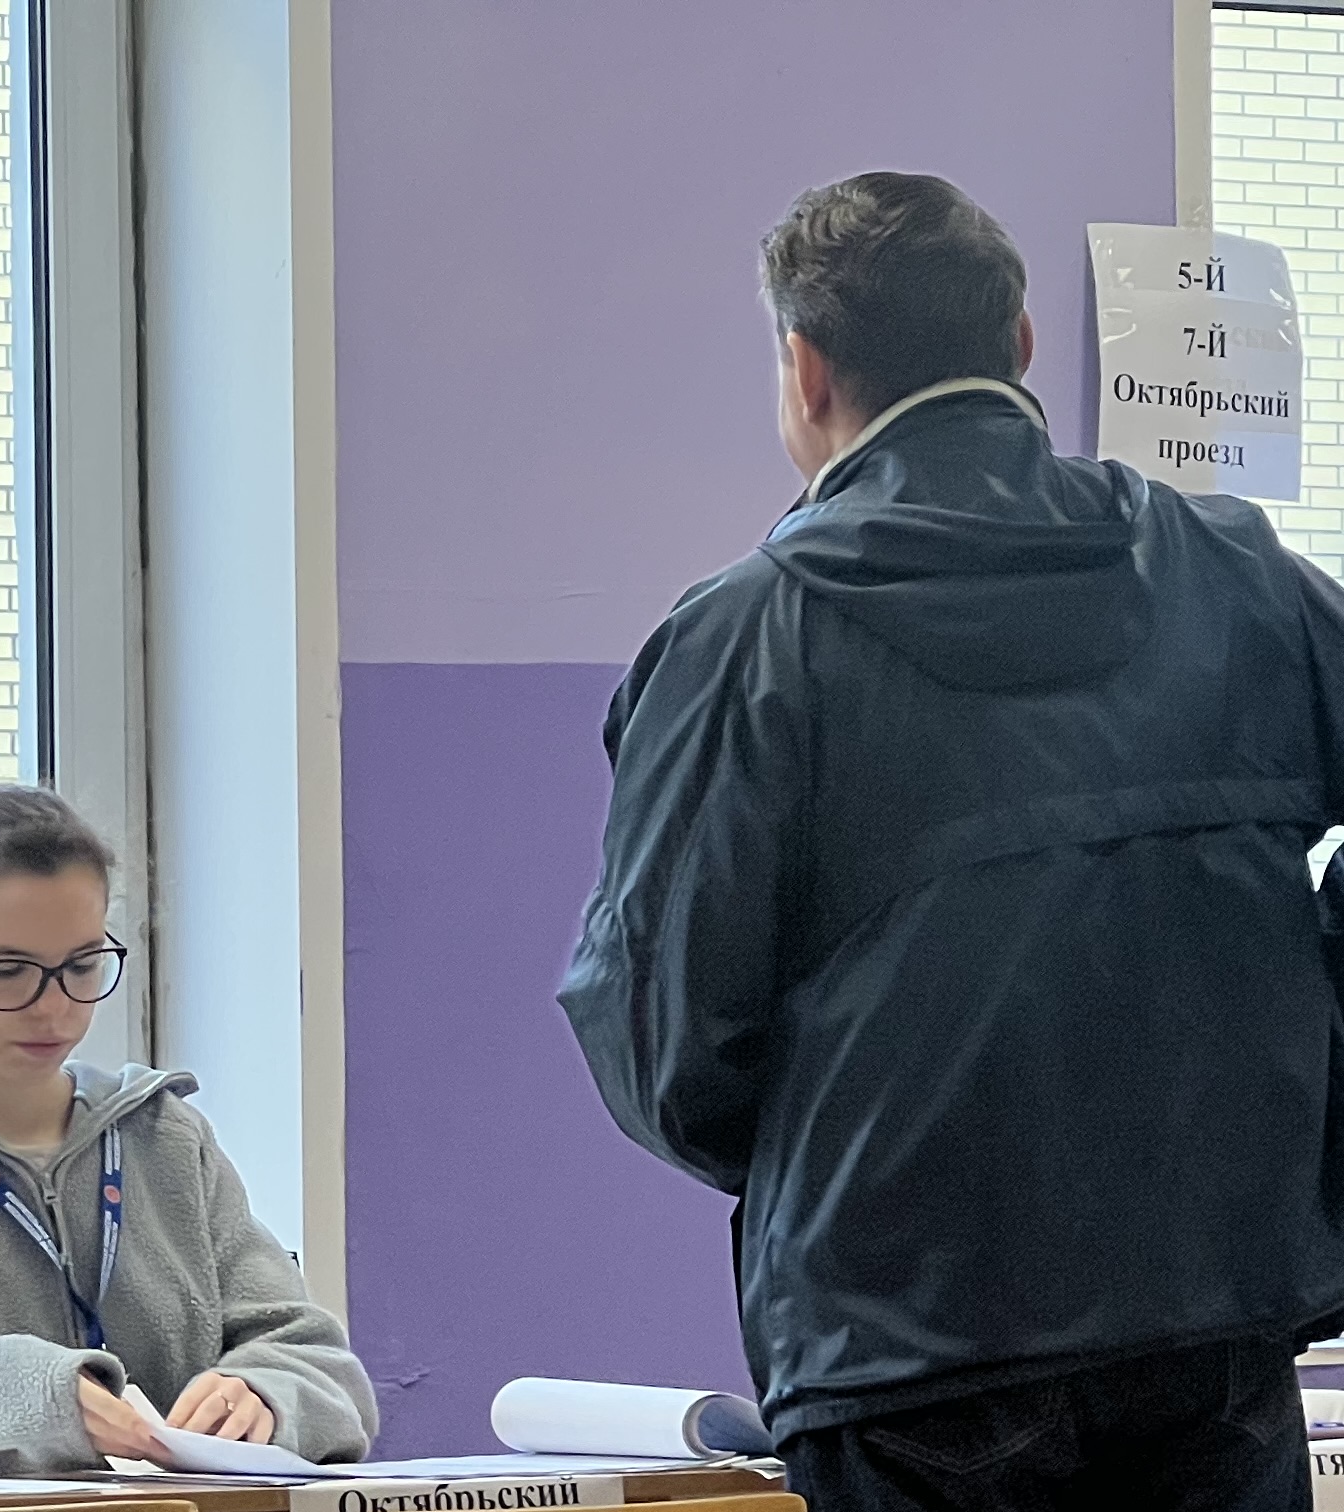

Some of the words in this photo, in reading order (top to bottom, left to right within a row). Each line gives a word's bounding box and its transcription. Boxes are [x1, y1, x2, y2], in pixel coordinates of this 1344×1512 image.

[1177, 255, 1226, 293] 5-Й
[1183, 322, 1227, 359] 7-Й
[1113, 373, 1290, 418] Октябрьский
[1158, 438, 1245, 470] проезд
